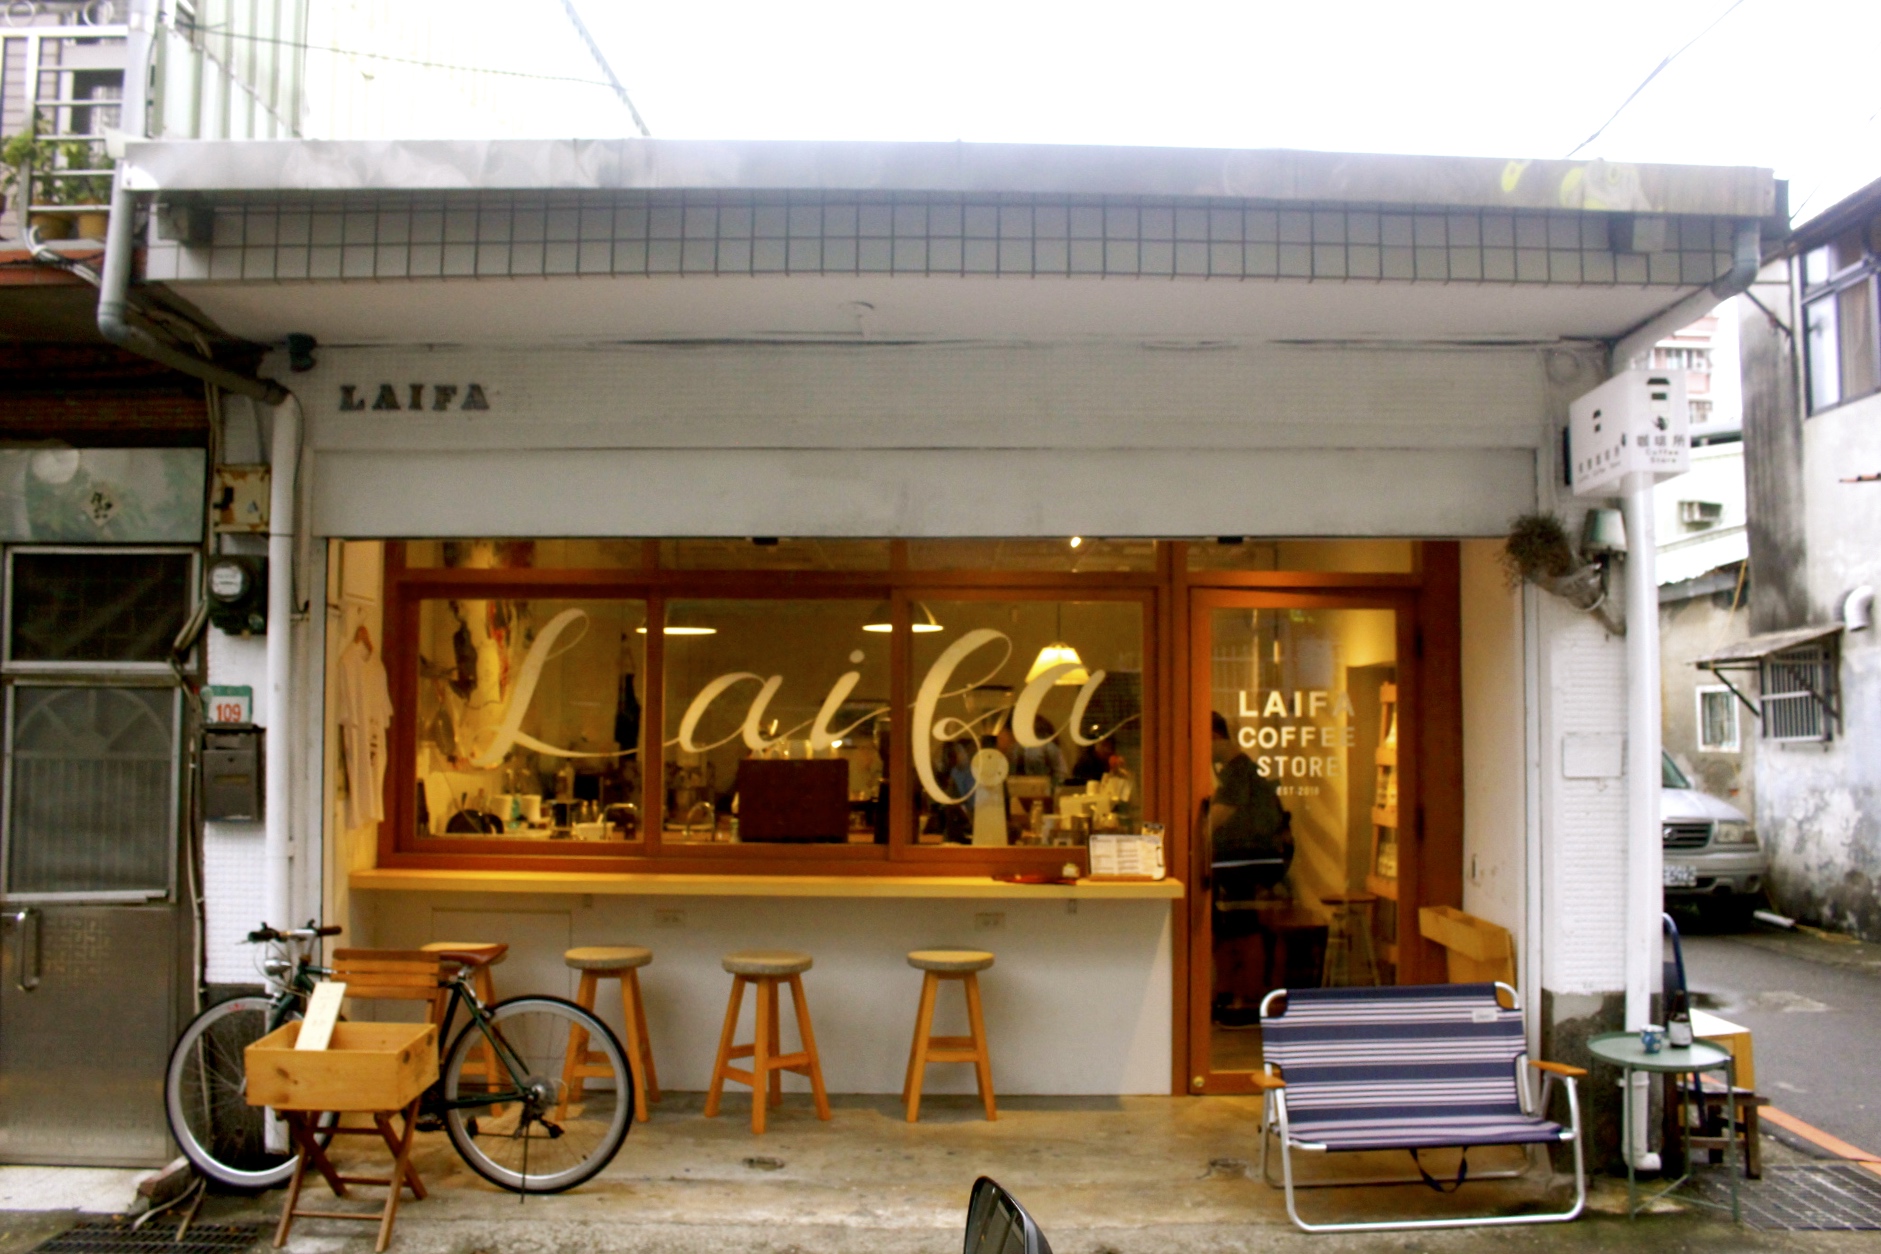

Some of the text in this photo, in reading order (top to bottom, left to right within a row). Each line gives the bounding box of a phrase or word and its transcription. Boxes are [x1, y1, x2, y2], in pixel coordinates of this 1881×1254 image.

[338, 383, 490, 411] LAIFA
[216, 703, 242, 723] 109
[467, 608, 1140, 805] Laifa
[1238, 690, 1356, 718] LAIFA
[1237, 726, 1356, 749] COFFEE
[1256, 755, 1340, 778] STORE
